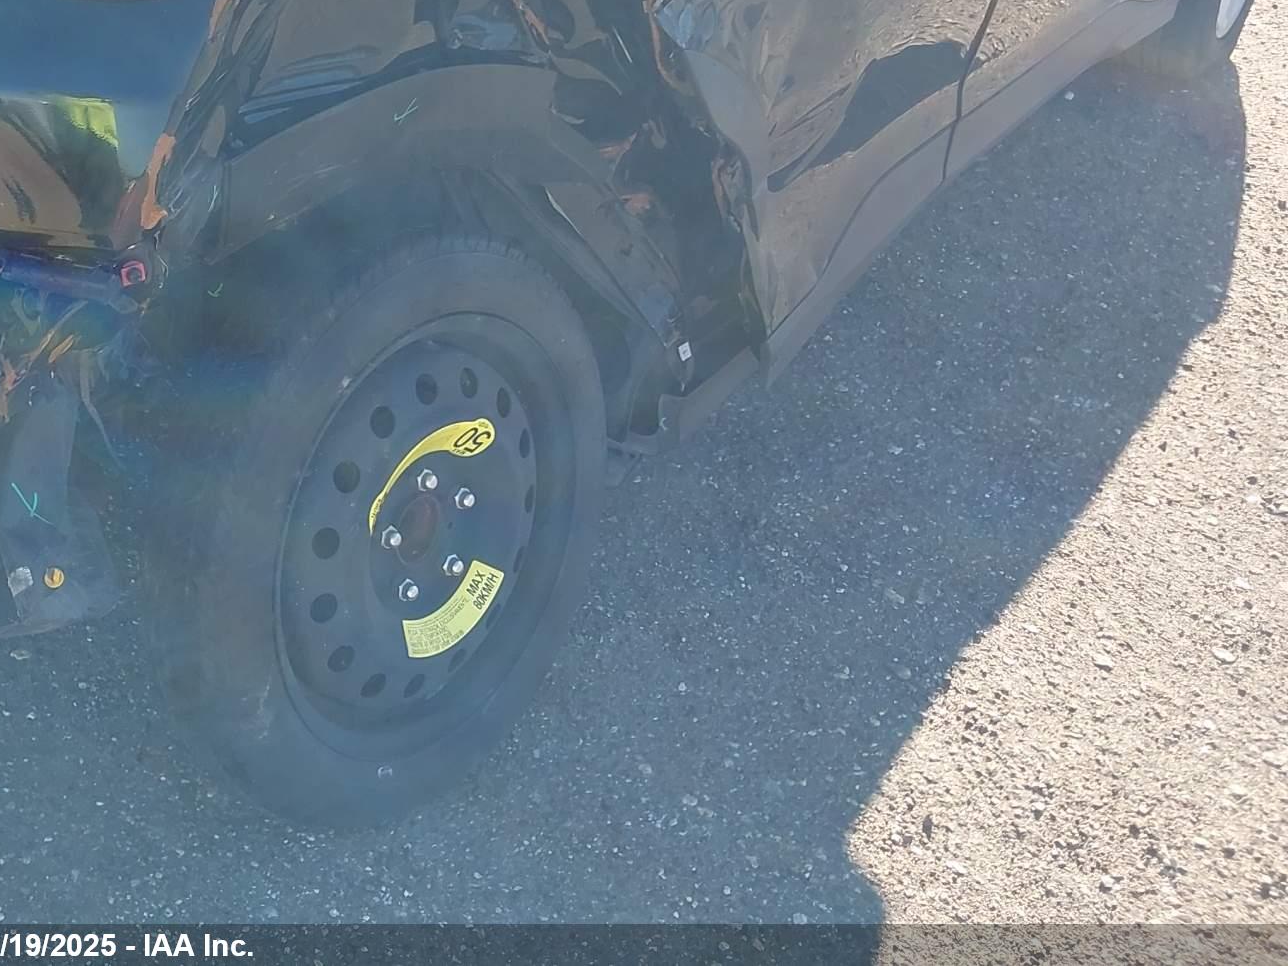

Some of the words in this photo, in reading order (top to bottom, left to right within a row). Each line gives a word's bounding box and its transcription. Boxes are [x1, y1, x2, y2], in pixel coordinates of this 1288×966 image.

[453, 427, 492, 453] 50
[465, 569, 486, 597] MAX
[473, 572, 499, 610] 80KM/H
